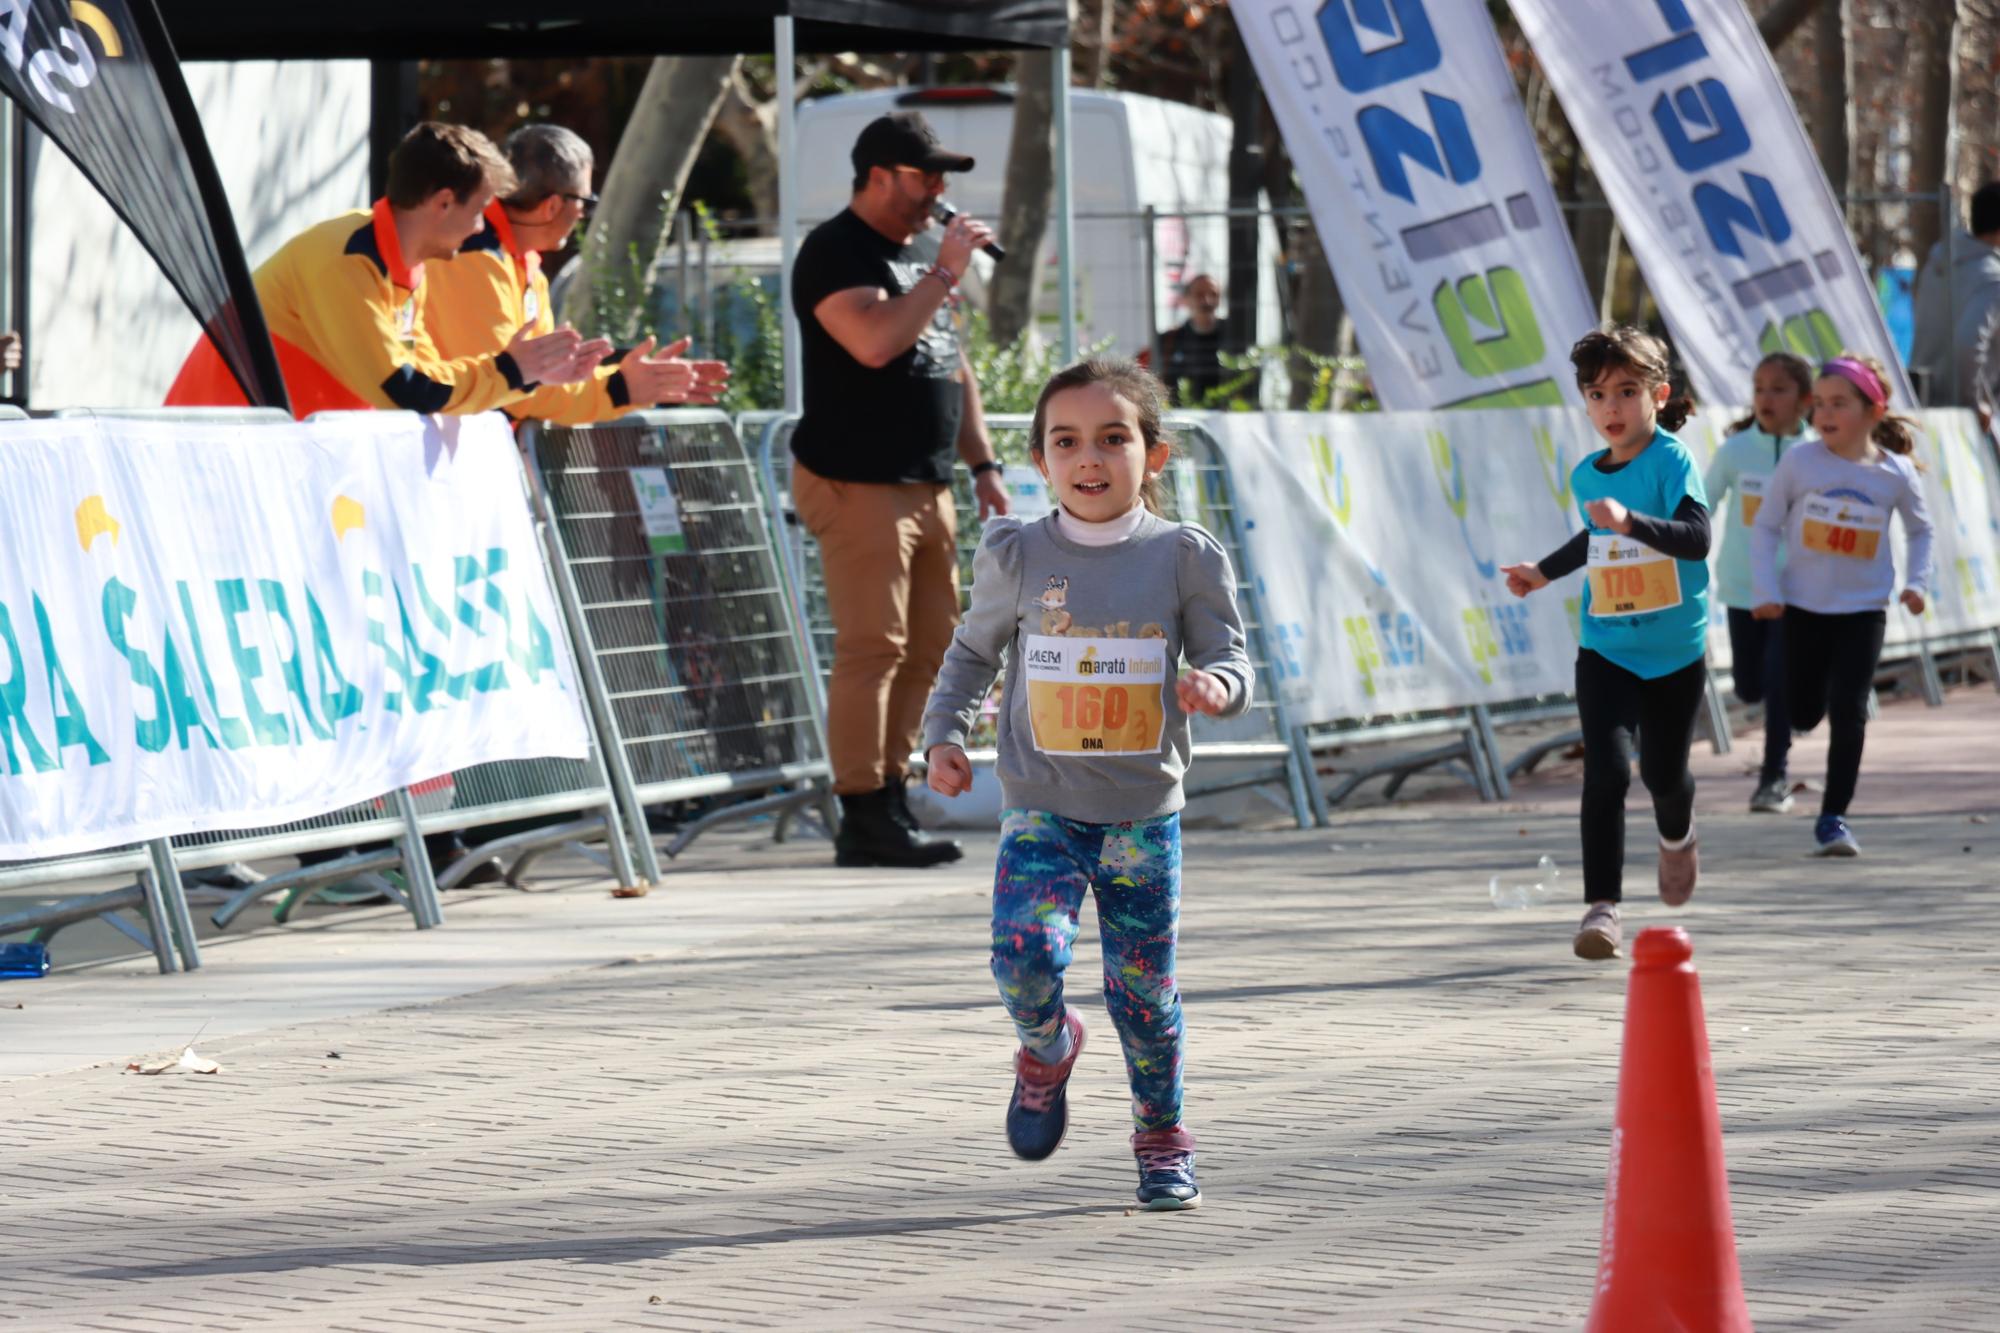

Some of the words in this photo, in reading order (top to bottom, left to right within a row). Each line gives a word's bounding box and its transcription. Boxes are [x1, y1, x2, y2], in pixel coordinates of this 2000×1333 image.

[1827, 527, 1857, 554] 40
[1601, 566, 1645, 599] 170
[1028, 649, 1062, 664] SALERA
[1079, 657, 1125, 674] marató
[1056, 685, 1129, 730] 160
[1081, 737, 1104, 750] ONA
